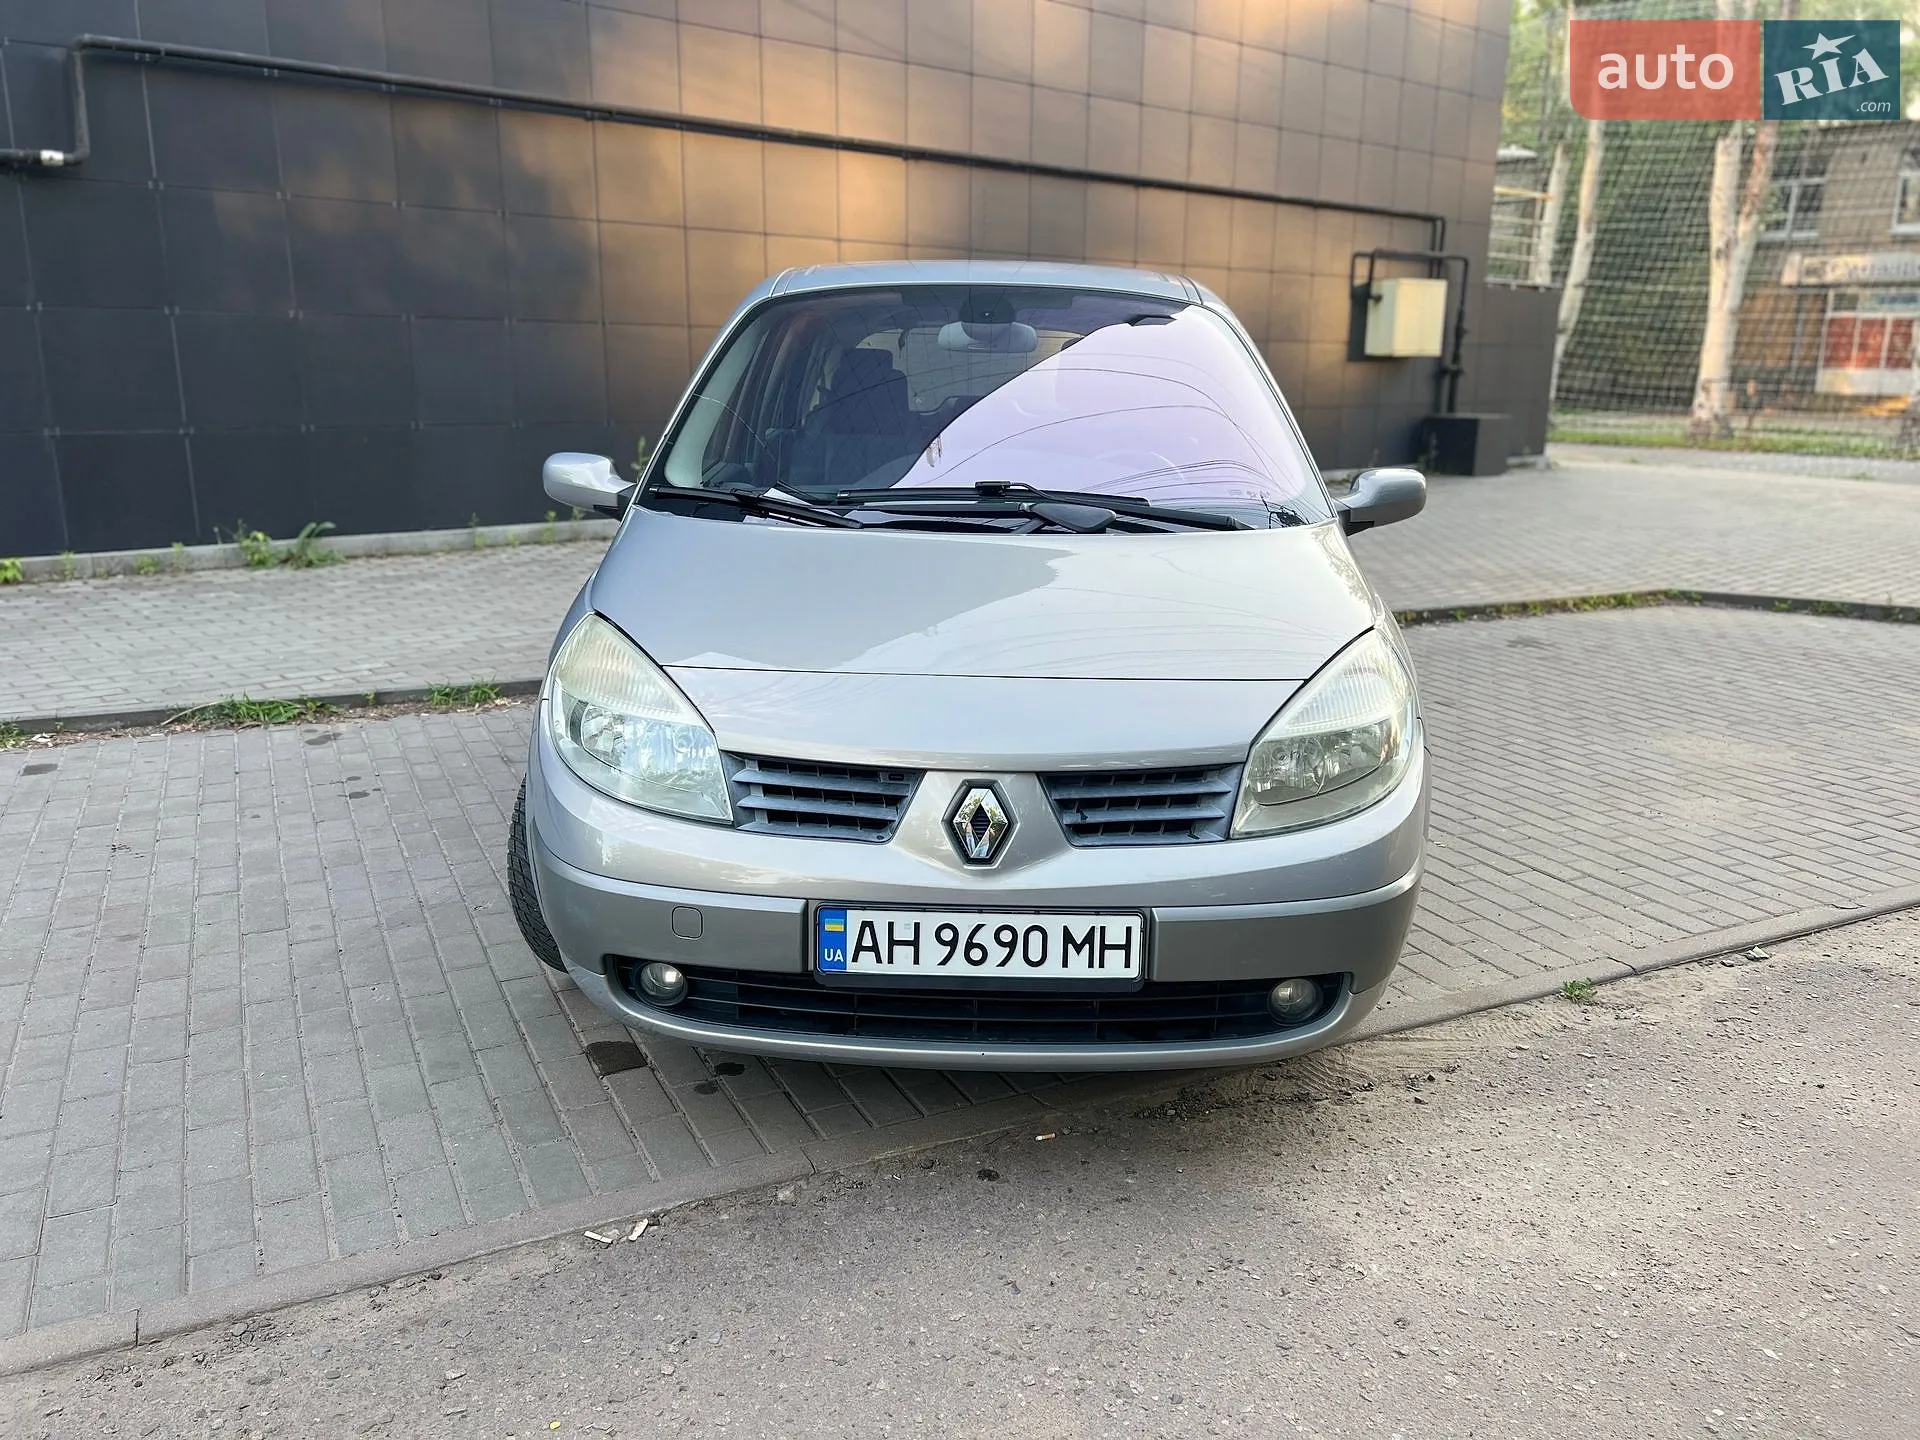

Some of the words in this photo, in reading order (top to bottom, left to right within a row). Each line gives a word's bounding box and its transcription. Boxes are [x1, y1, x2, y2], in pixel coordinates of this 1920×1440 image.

[824, 948, 844, 962] UA
[851, 920, 920, 965] AH
[934, 922, 1049, 968] 9690
[1062, 924, 1132, 968] MH
